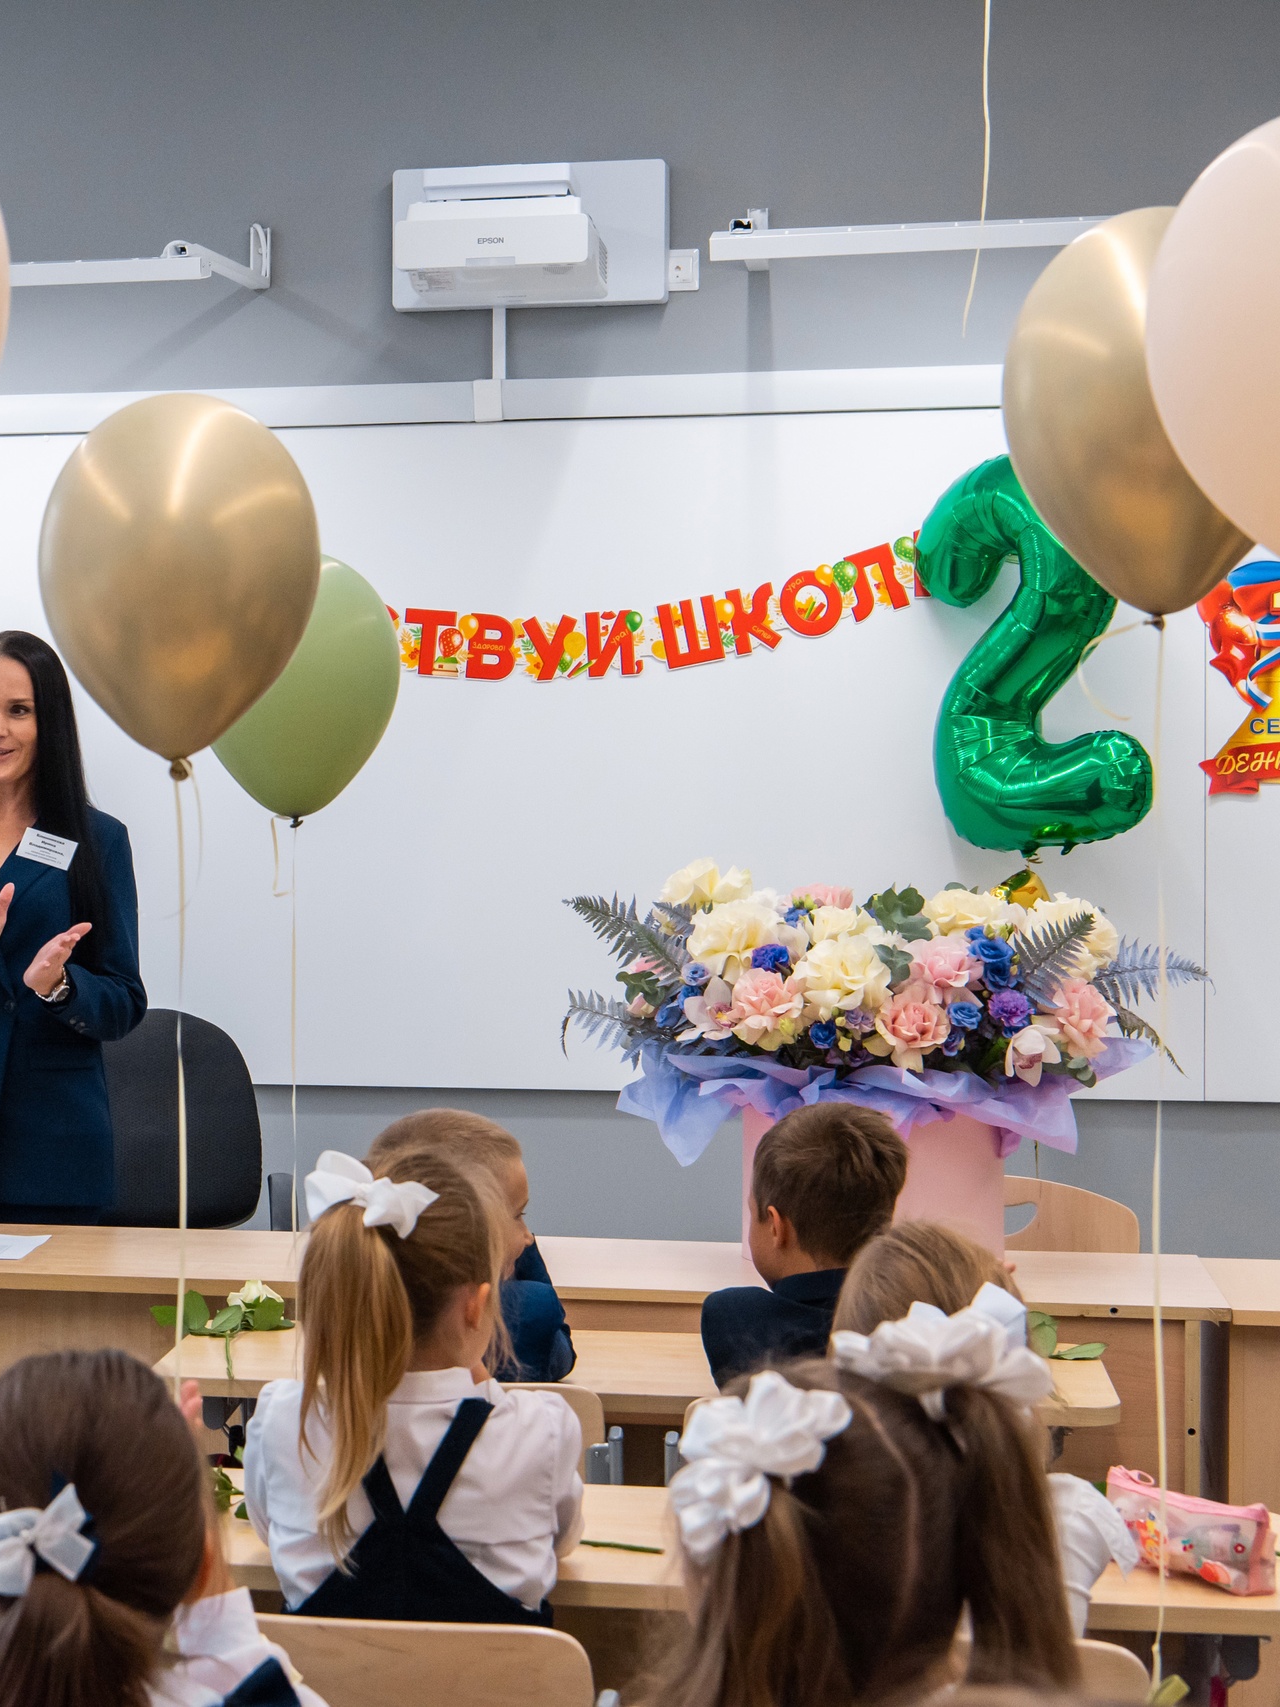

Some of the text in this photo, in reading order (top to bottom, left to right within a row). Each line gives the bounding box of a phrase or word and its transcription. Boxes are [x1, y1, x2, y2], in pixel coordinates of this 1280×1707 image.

[477, 236, 505, 245] EPSON
[385, 530, 931, 681] ТВУЙ, ШКОЛ
